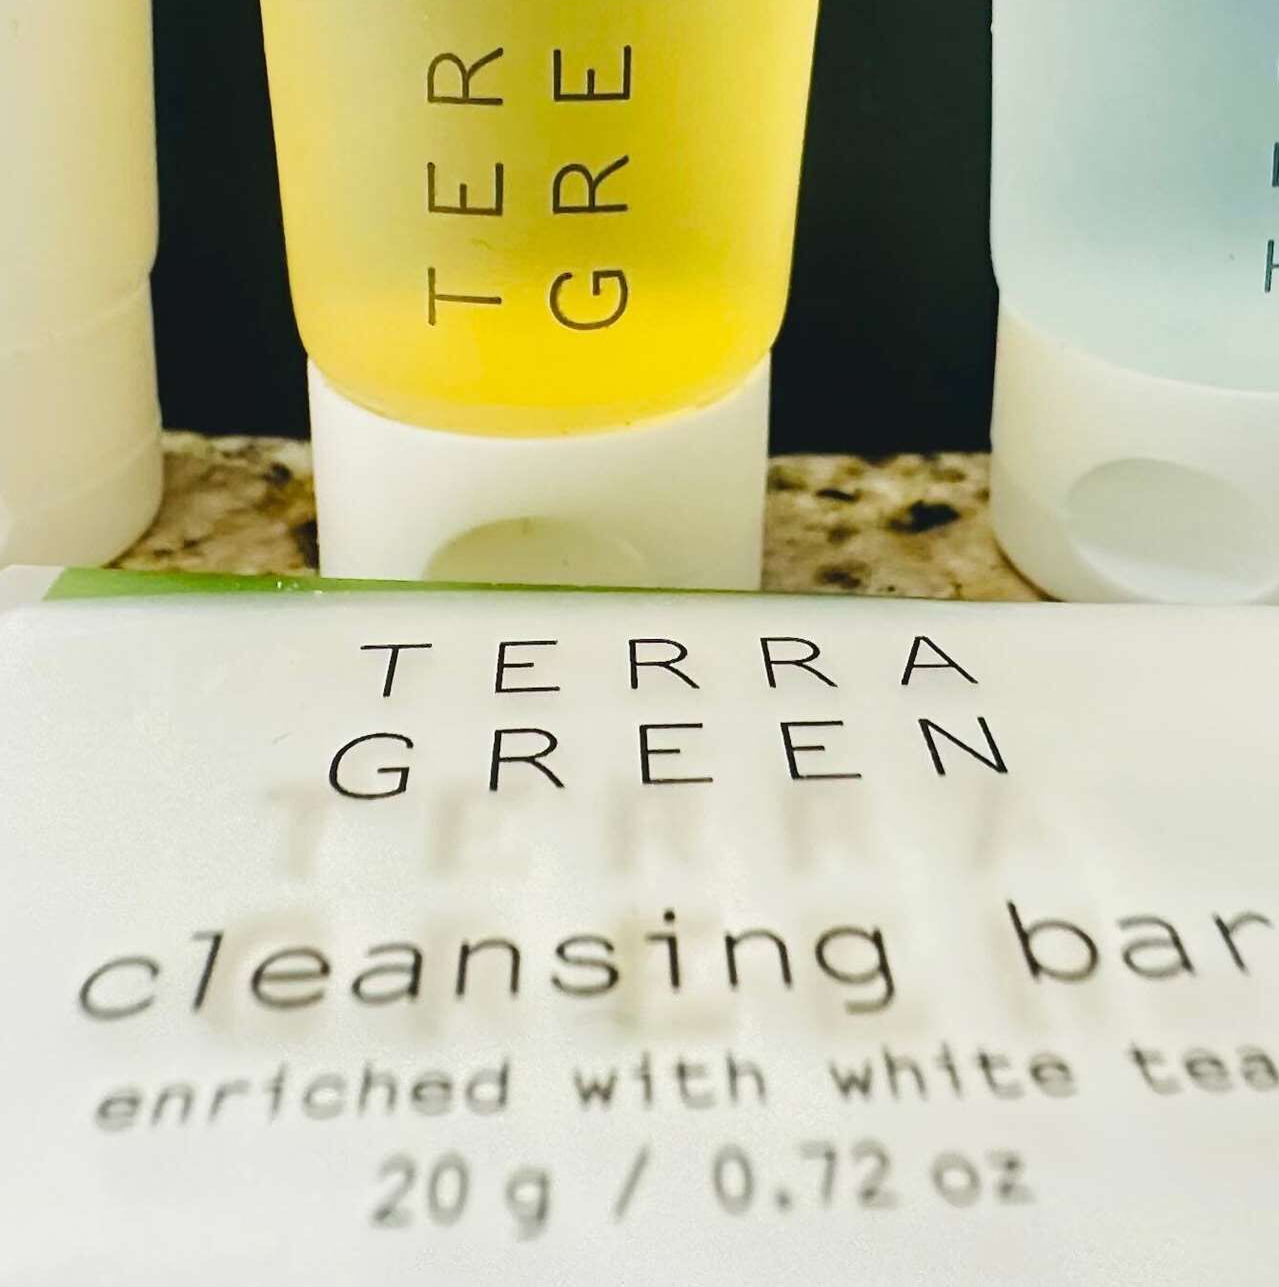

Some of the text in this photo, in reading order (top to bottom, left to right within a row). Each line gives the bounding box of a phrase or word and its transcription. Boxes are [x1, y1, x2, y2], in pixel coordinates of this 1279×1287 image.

[360, 635, 980, 699] TERRA
[327, 715, 1010, 801] GREEN
[76, 898, 1276, 1023] cleansing bar
[93, 1058, 513, 1137] enriched
[574, 1050, 770, 1112] with
[828, 1043, 1078, 1102] white
[367, 1141, 1038, 1242] 20 g / 0.72 oz
